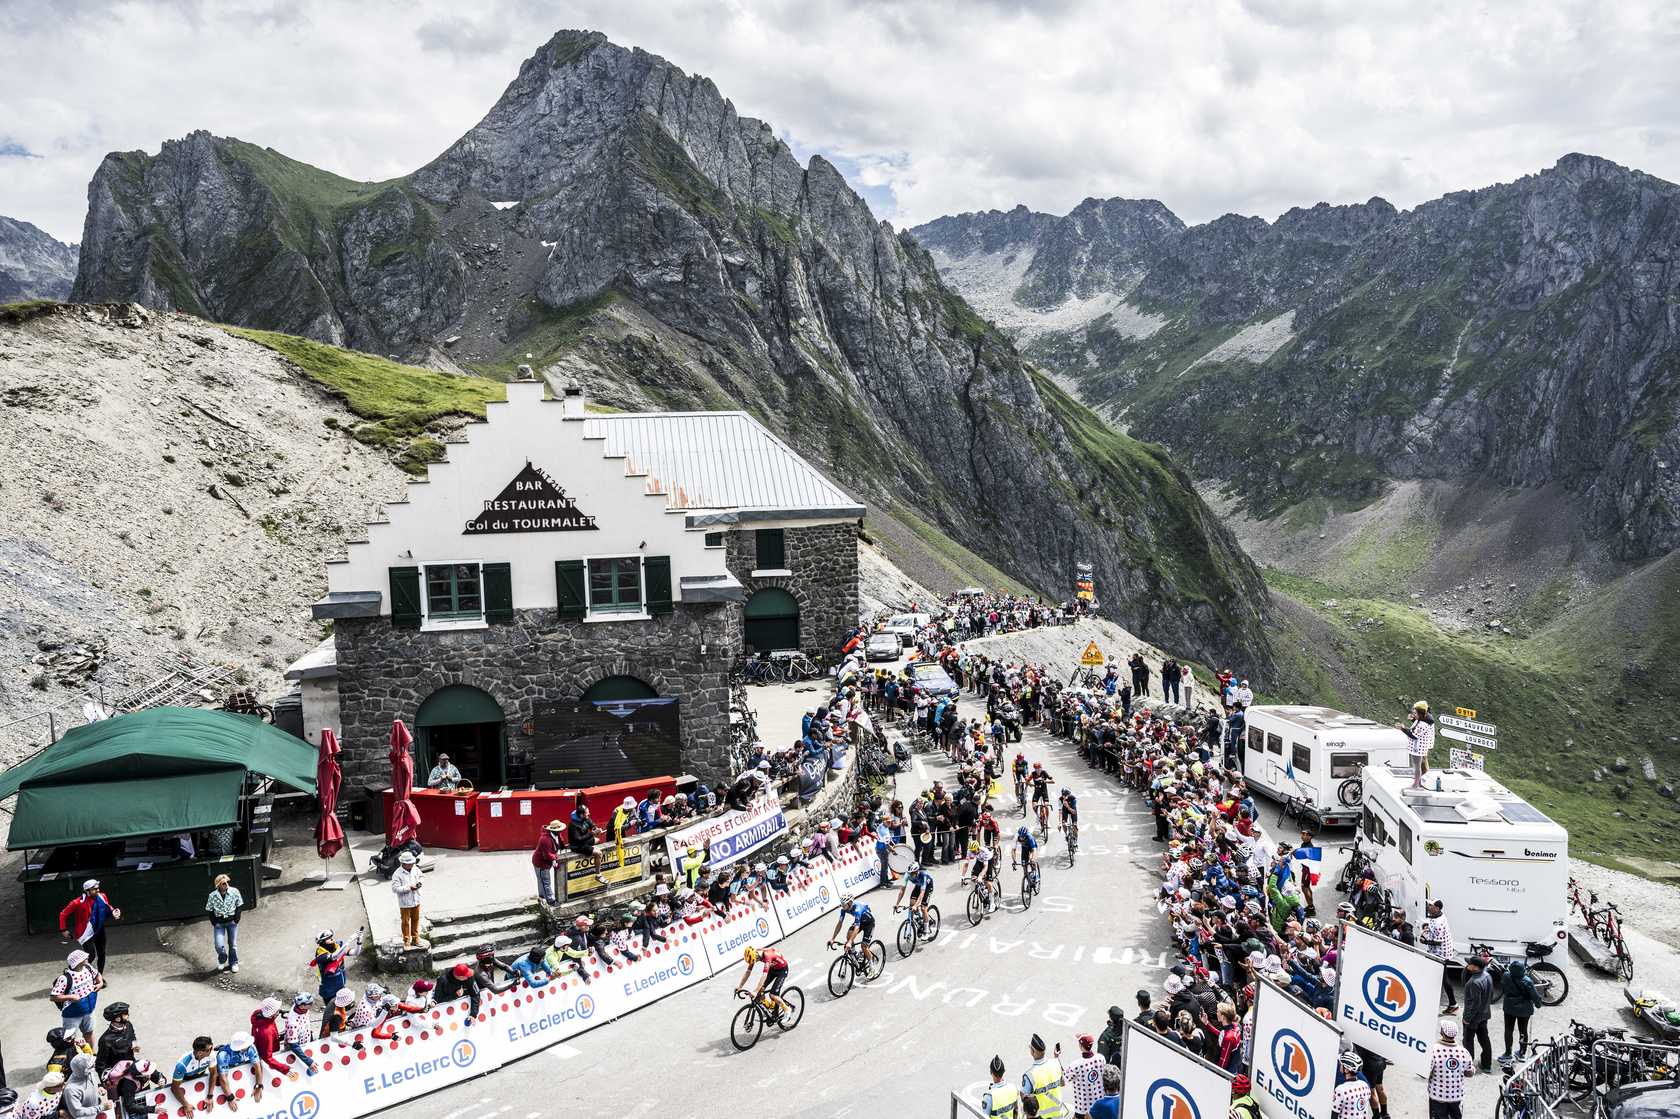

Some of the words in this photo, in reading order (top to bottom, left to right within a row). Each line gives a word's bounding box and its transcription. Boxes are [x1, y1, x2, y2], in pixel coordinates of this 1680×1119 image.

[515, 480, 543, 491] BAR
[484, 498, 575, 511] RESTAURANT
[466, 520, 488, 531] Col
[492, 519, 508, 530] du
[513, 516, 595, 529] TOURMALET
[1464, 722, 1493, 733] SAUVEUR
[1465, 735, 1494, 748] LOURDES
[724, 818, 734, 831] ET
[735, 816, 780, 852] ARMIRAIL
[575, 846, 640, 869] ZOOPHTO
[843, 868, 876, 889] E.Leclerc
[786, 895, 820, 920] E.Leclerc
[717, 928, 757, 955] E.Leclerc
[936, 929, 1167, 968] RMIRAIL
[624, 965, 678, 997] E.Leclerc
[508, 1007, 576, 1042] E.Leclerc
[1343, 1003, 1428, 1053] E.Leclerc
[363, 1054, 451, 1095] E.Leclerc
[1256, 1069, 1315, 1119] E.Lecle
